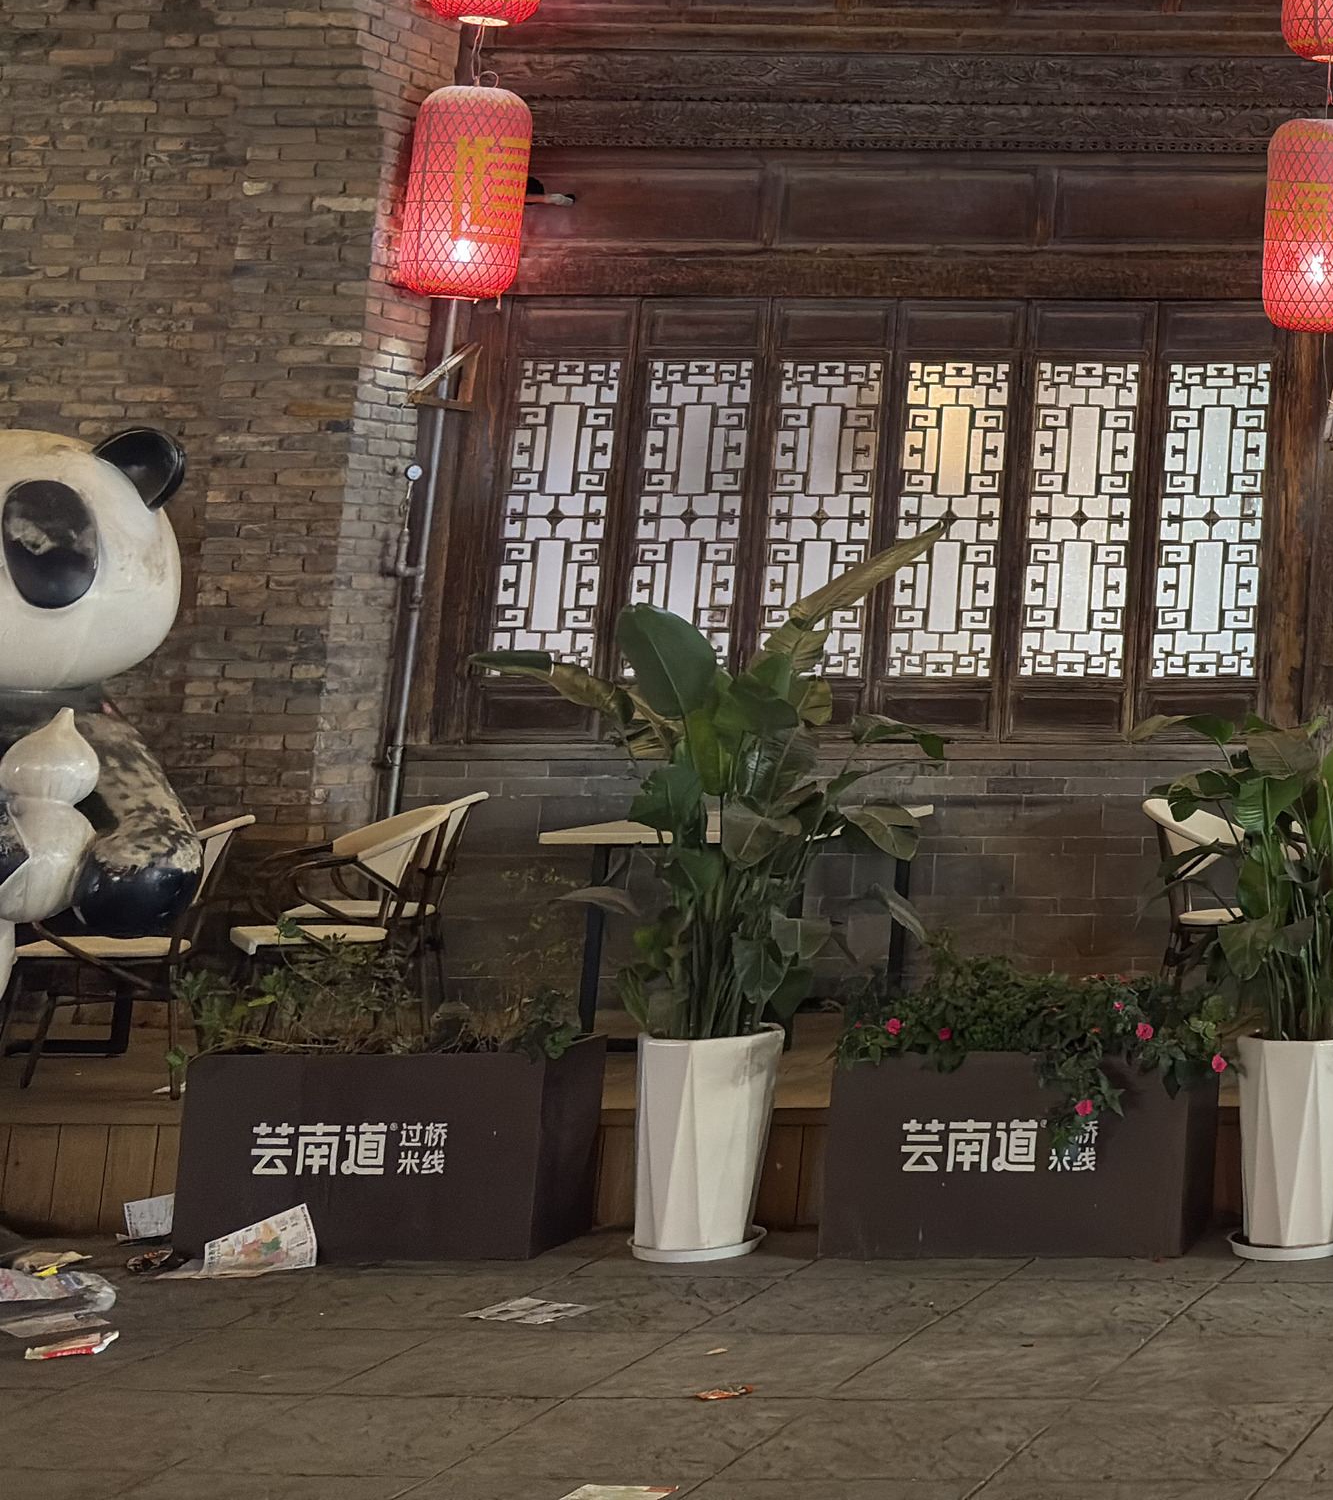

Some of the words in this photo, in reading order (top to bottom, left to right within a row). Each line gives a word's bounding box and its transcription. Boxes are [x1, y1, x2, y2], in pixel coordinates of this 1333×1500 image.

[250, 1121, 387, 1176] 芸南道
[398, 1121, 448, 1148] 过桥
[900, 1118, 1038, 1173] 芸南道
[396, 1149, 446, 1176] 米线
